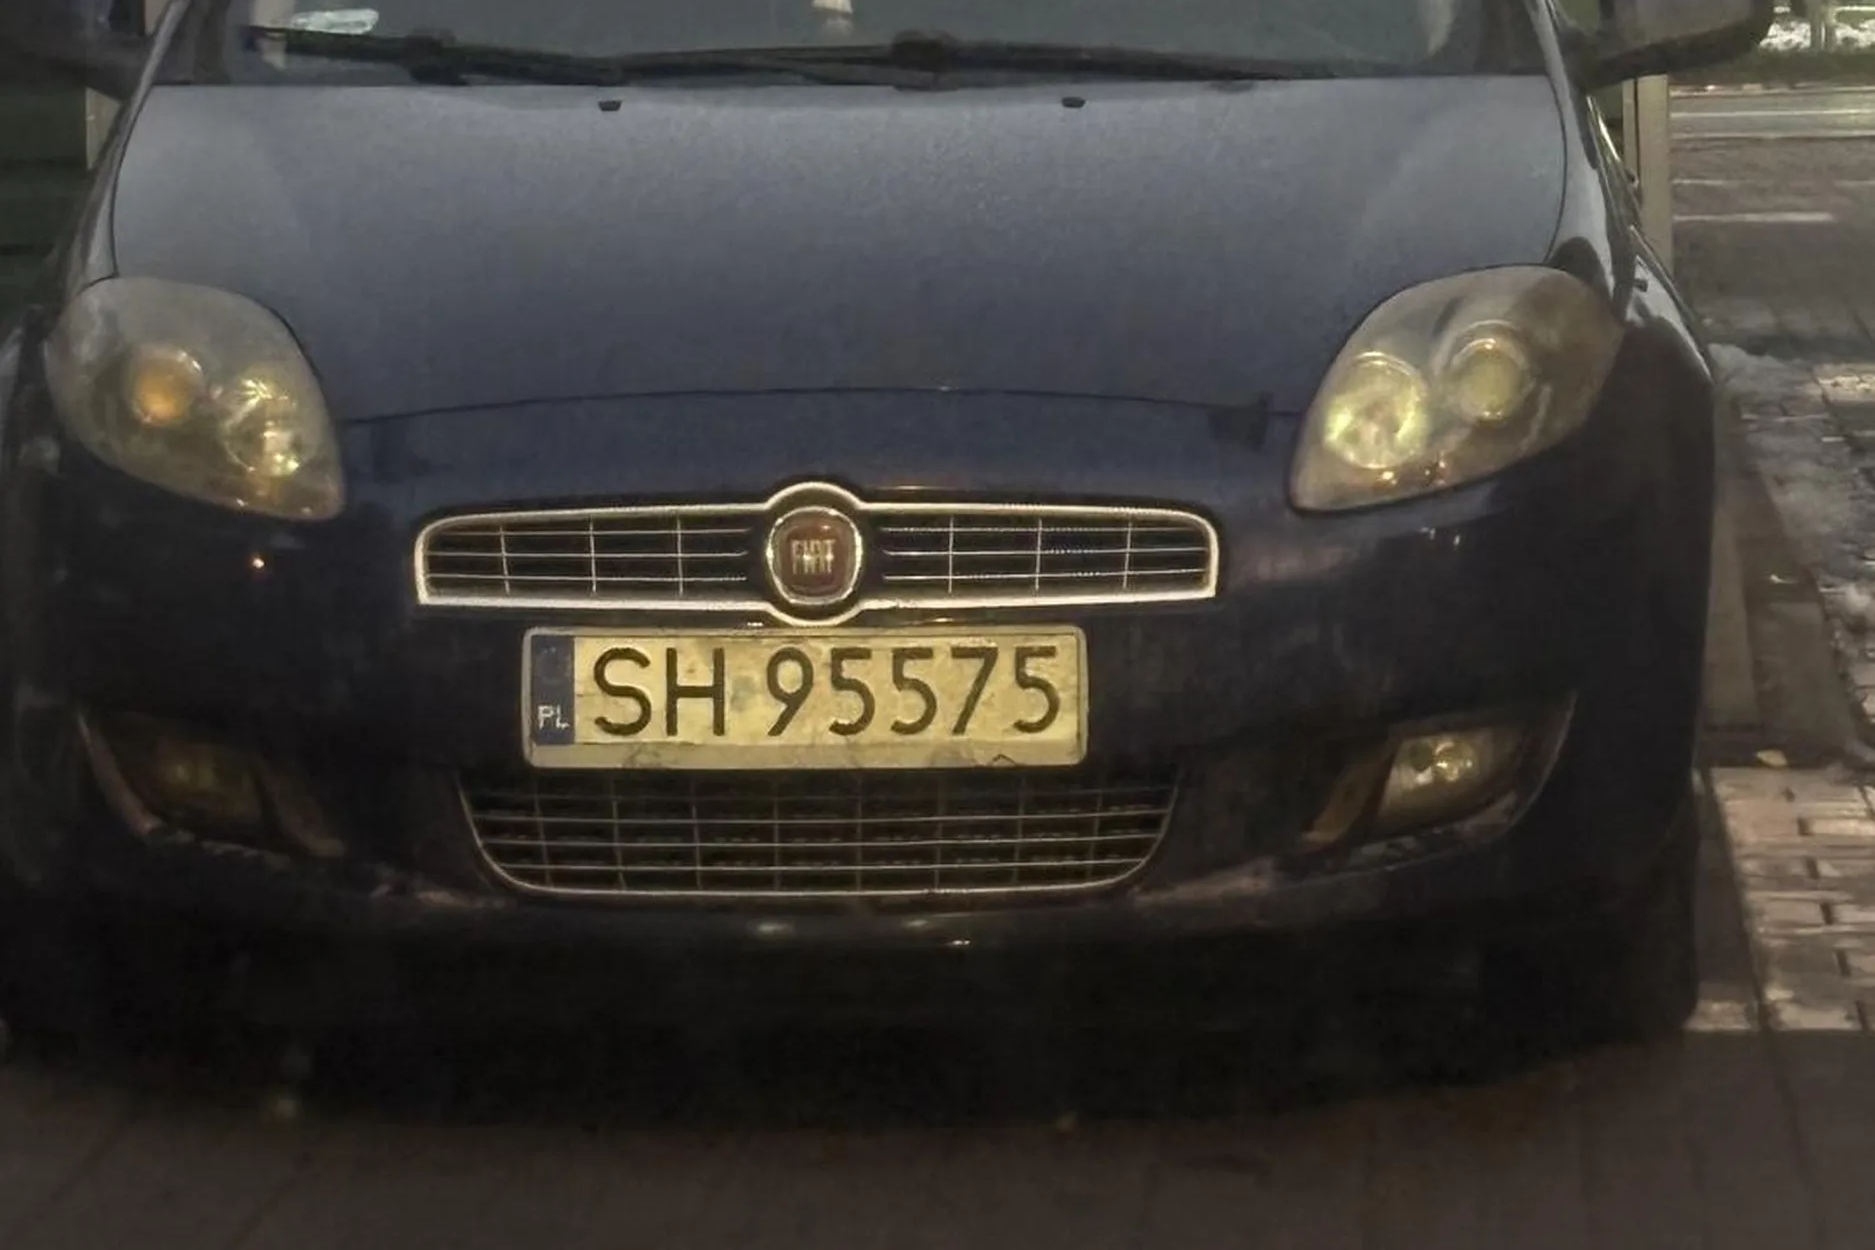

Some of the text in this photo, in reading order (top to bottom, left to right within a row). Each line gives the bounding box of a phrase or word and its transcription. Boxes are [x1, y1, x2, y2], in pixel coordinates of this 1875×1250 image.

[792, 539, 837, 574] FIAT
[593, 645, 1060, 737] SH 95575
[537, 705, 571, 729] PL
